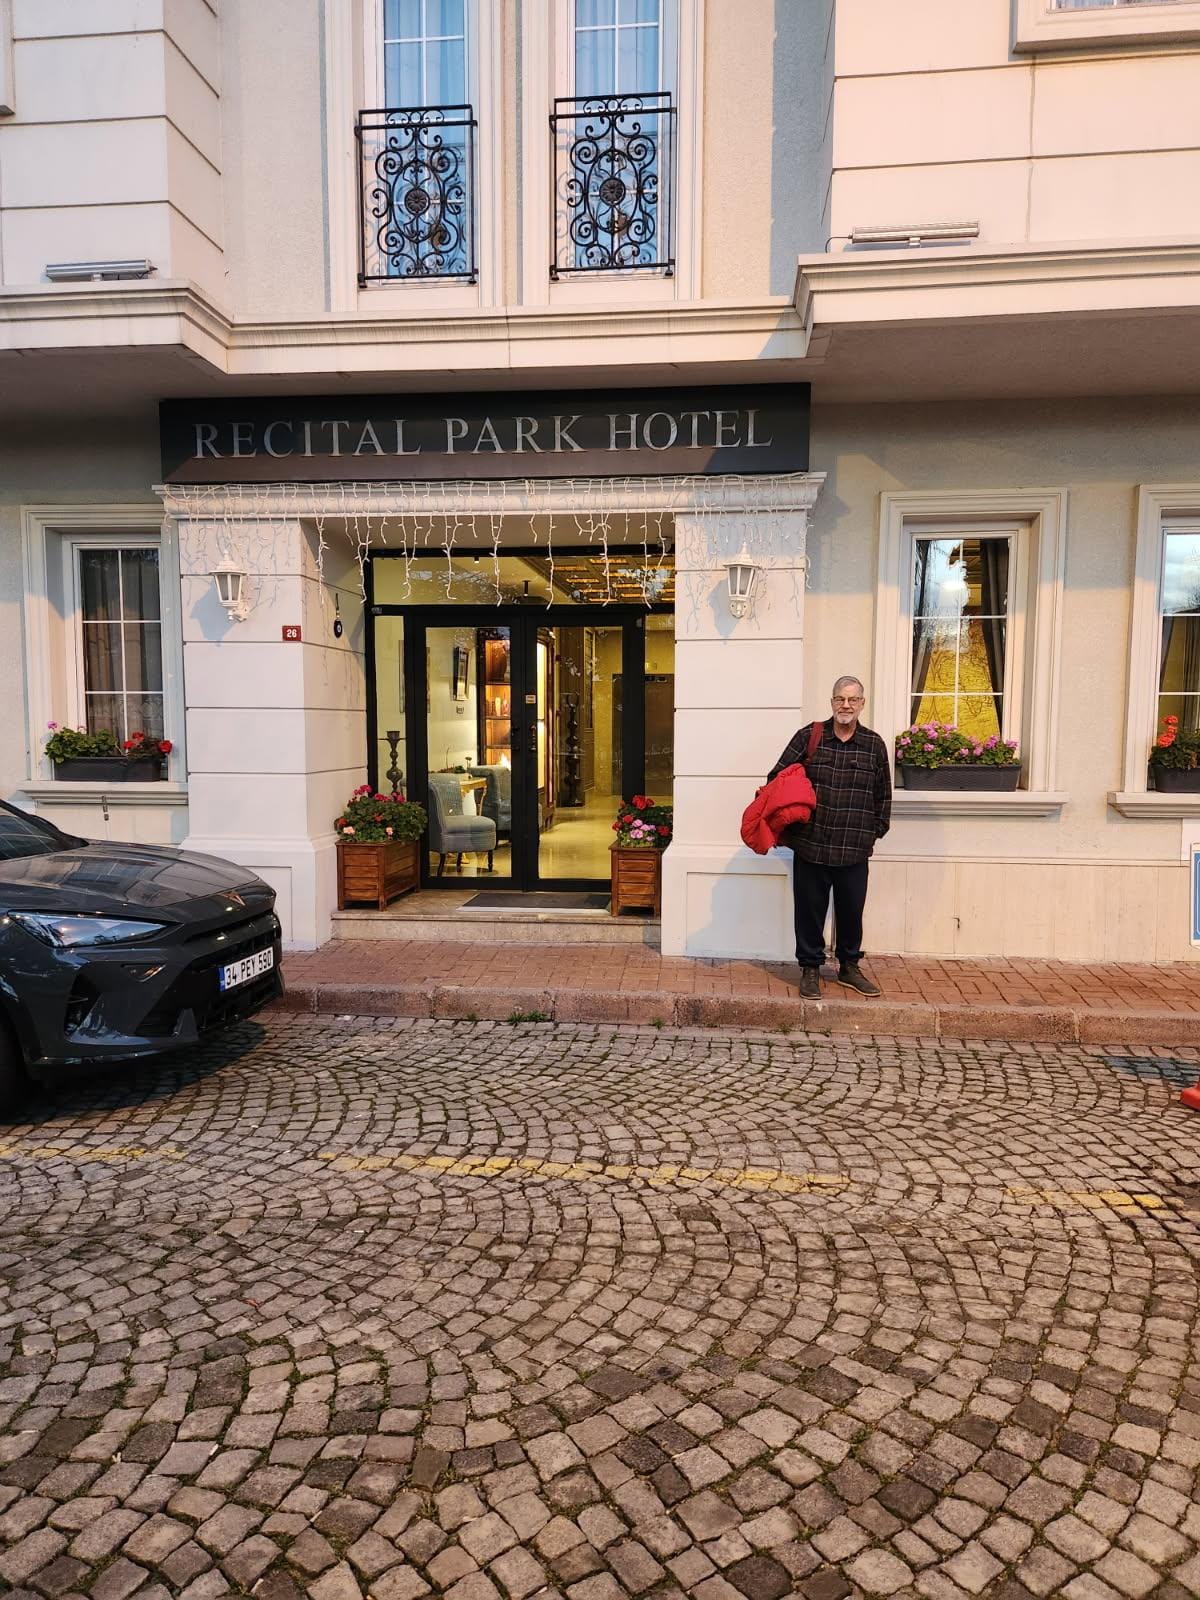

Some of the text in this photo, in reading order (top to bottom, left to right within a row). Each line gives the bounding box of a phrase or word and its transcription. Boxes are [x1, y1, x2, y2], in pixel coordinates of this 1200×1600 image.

[192, 408, 774, 459] RECITAL PARK HOTEL
[286, 628, 297, 638] 26
[225, 949, 272, 986] 34 PEY 590
